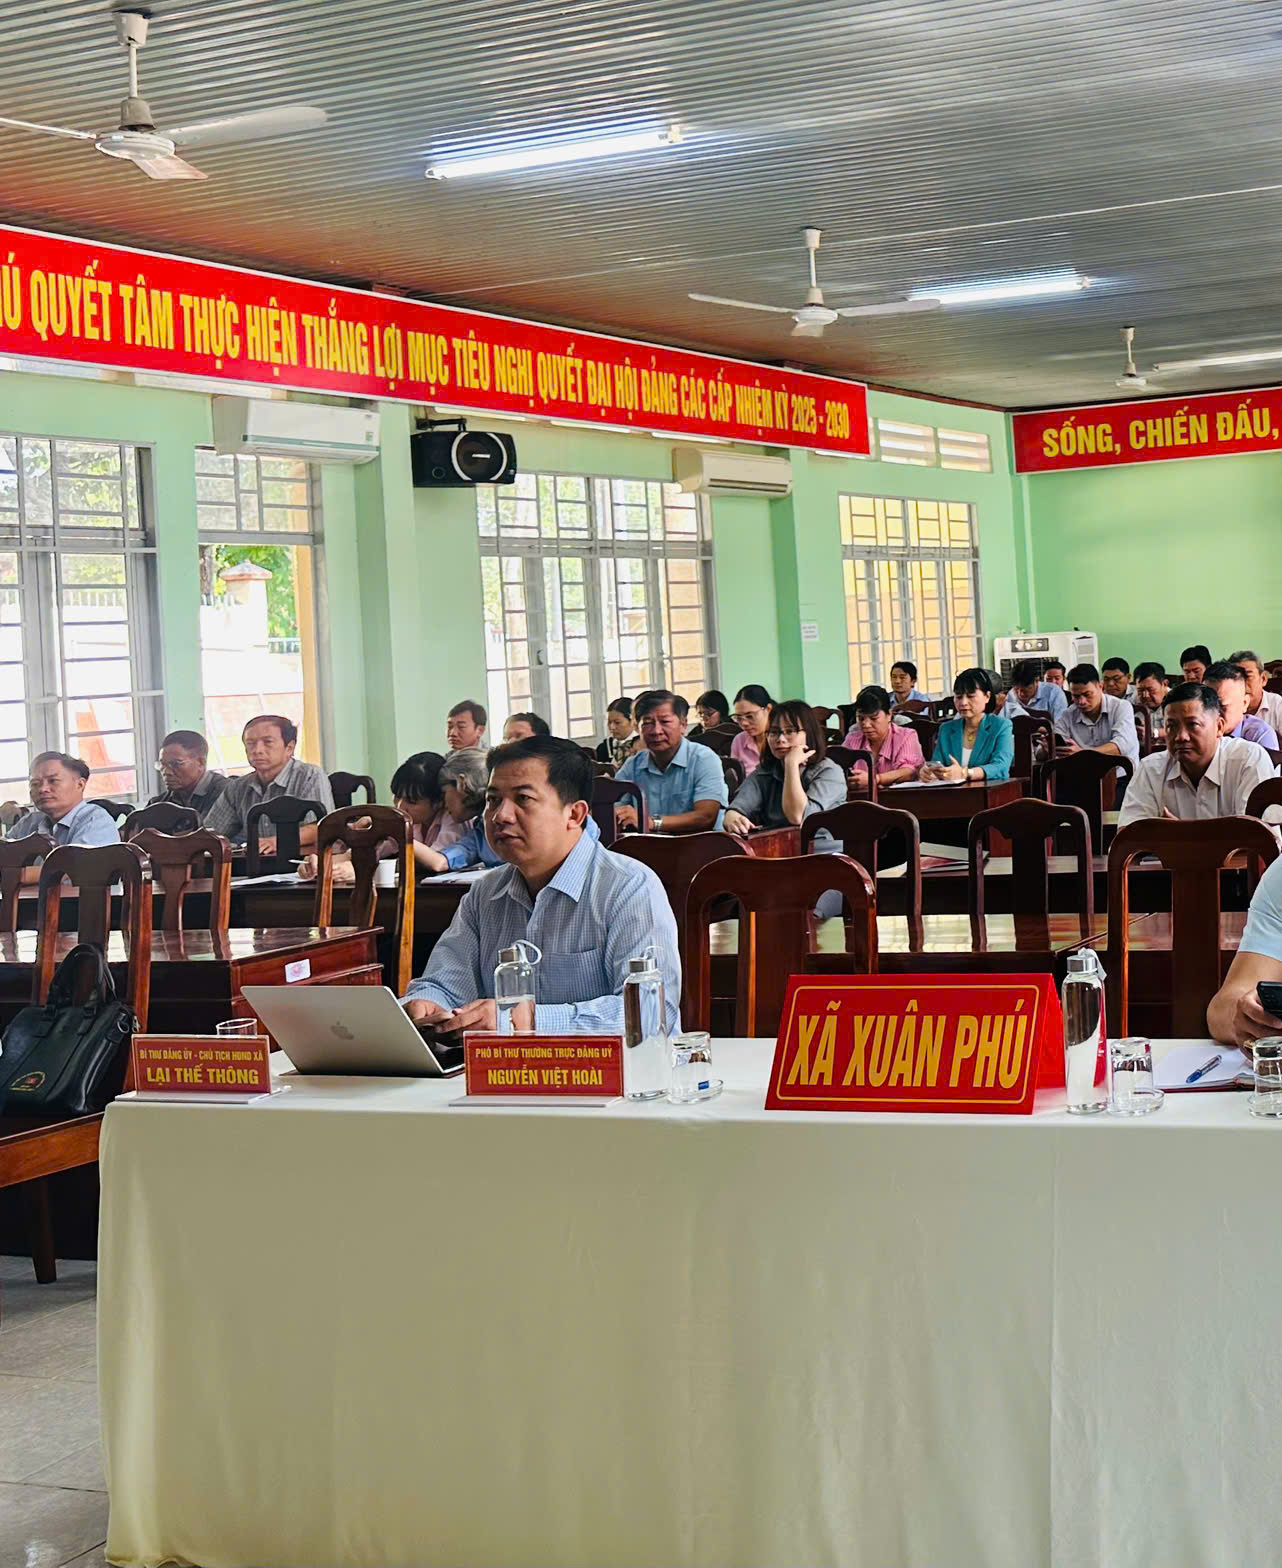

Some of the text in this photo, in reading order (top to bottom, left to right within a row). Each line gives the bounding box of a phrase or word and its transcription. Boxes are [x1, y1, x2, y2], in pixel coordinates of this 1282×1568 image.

[30, 260, 112, 341] QUYẾT
[120, 274, 174, 349] TÂM
[180, 296, 240, 368] THỰC
[246, 297, 297, 376] HIỆN
[302, 299, 369, 375] THẮNG
[373, 323, 403, 390] LỢI
[408, 332, 448, 395] MỤC
[452, 330, 490, 390] TIÊU
[494, 345, 534, 407] NGHỊ
[537, 344, 582, 403] QUYẾT
[587, 360, 611, 416] ĐẠI
[614, 360, 638, 419] HỘI
[641, 358, 678, 415] ĐẢNG
[681, 368, 706, 419] CÁC
[709, 368, 732, 422] CẤP
[736, 380, 773, 436] NHIỆM
[775, 385, 788, 428] KỲ
[792, 394, 816, 434] 2025
[826, 401, 849, 438] 2030
[1043, 416, 1120, 456] SỐNG,
[1130, 408, 1208, 448] CHIẾN
[1216, 400, 1278, 440] ĐẤU,
[199, 1048, 213, 1060] CHỦ
[215, 1051, 231, 1062] TỊCH
[475, 1046, 491, 1058] PHÓ
[494, 1046, 502, 1058] BÍ
[504, 1047, 520, 1058] THƯ
[521, 1046, 552, 1058] THƯỜNG
[554, 1047, 575, 1060] TRỰC
[577, 1045, 600, 1058] ĐẢNG
[786, 999, 1028, 1089] XÃ XUÂN PHÚ
[146, 1063, 259, 1085] LẠI THẾ THÔNG
[487, 1064, 603, 1088] NGUYỄN VIỆT HOÀI
